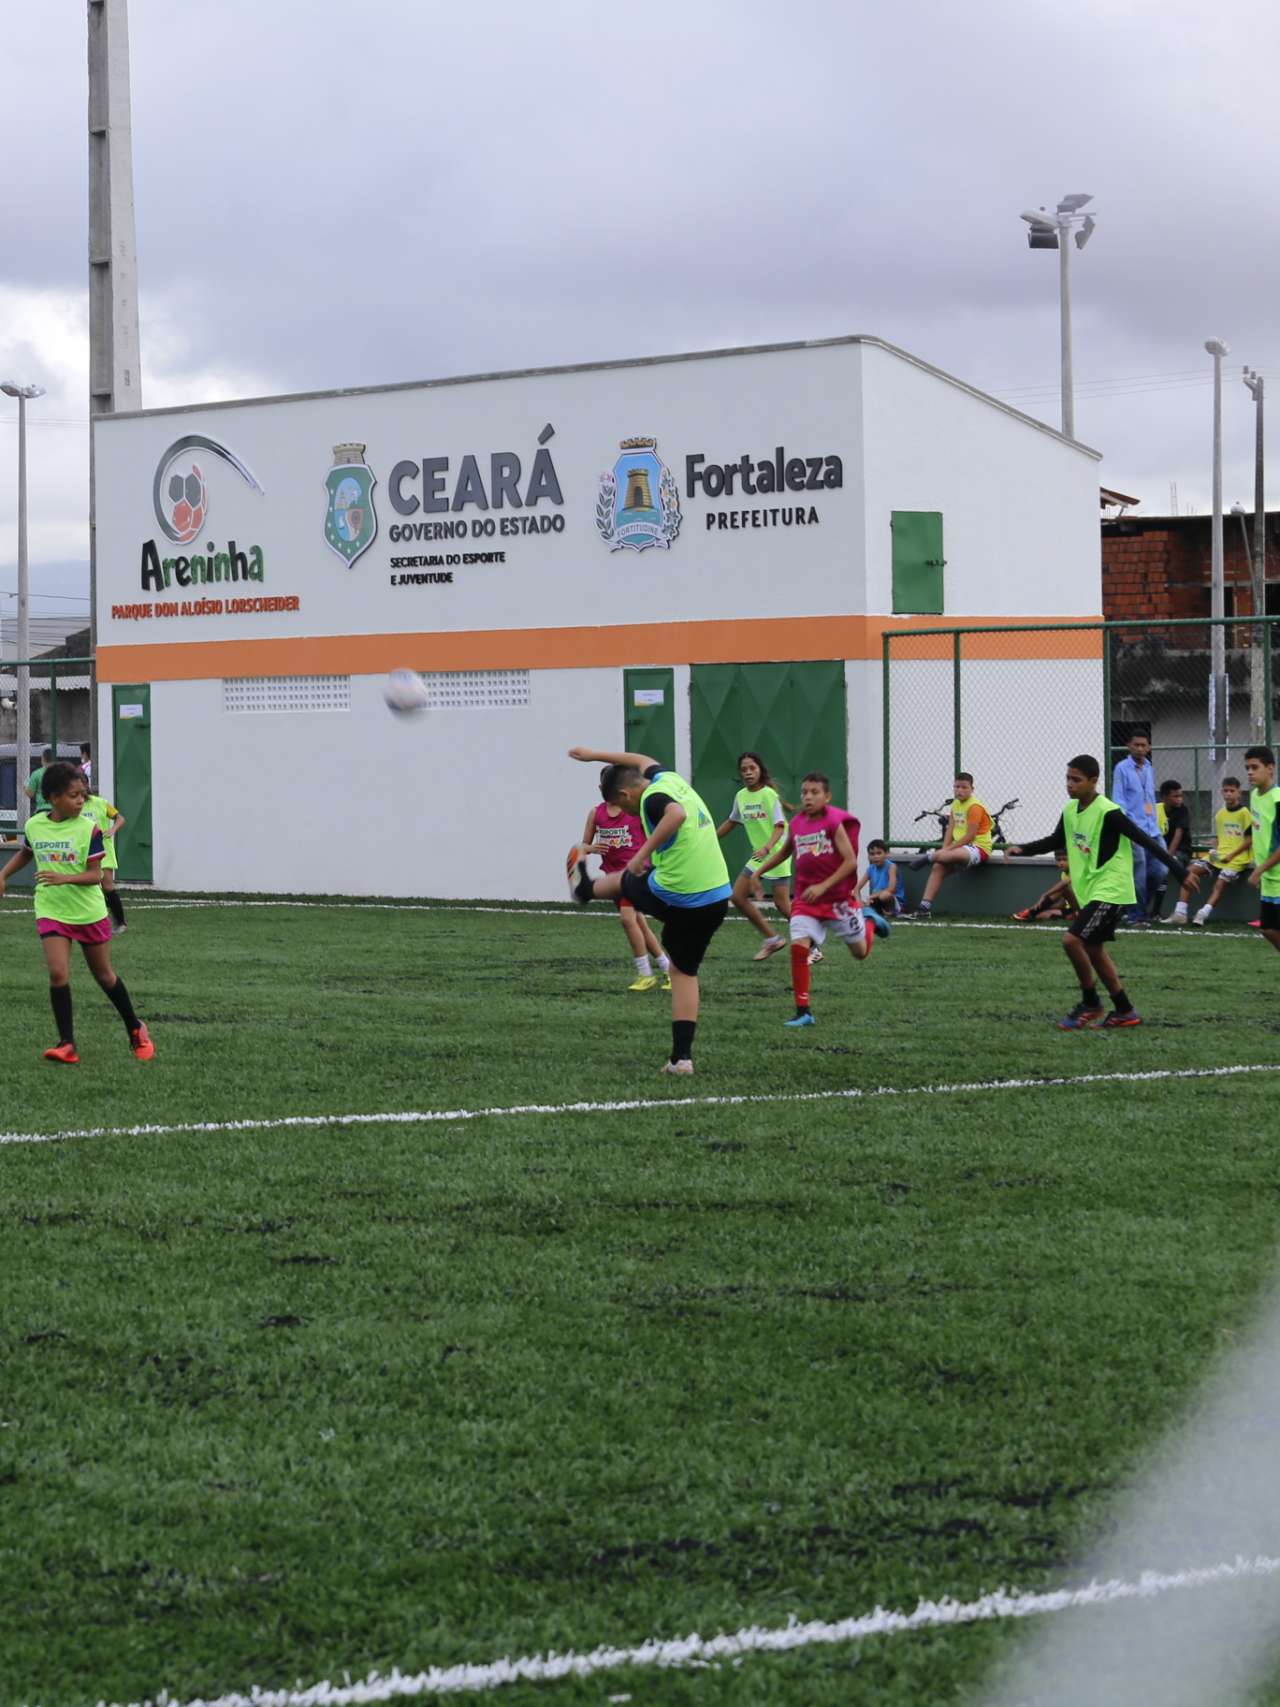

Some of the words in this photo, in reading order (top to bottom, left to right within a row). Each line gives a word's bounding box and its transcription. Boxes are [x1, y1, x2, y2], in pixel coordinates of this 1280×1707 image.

[388, 423, 565, 516] CEARÁ
[685, 446, 844, 499] Fortaleza
[388, 519, 468, 543] GOVERNO
[471, 518, 496, 538] DO
[499, 513, 566, 537] ESTADO
[705, 505, 820, 531] PREFEITURA
[140, 539, 265, 593] Areninha
[389, 554, 445, 569] SECRETARIA
[446, 553, 462, 566] DO
[462, 551, 507, 565] ESPORTE
[390, 574, 398, 587] E
[398, 571, 455, 586] JUVENTUDE
[111, 604, 153, 621] PARQUE
[180, 596, 224, 617] ALOÍSIO
[224, 595, 301, 615] LORSCHEIDER
[34, 841, 71, 850] ESPORTE
